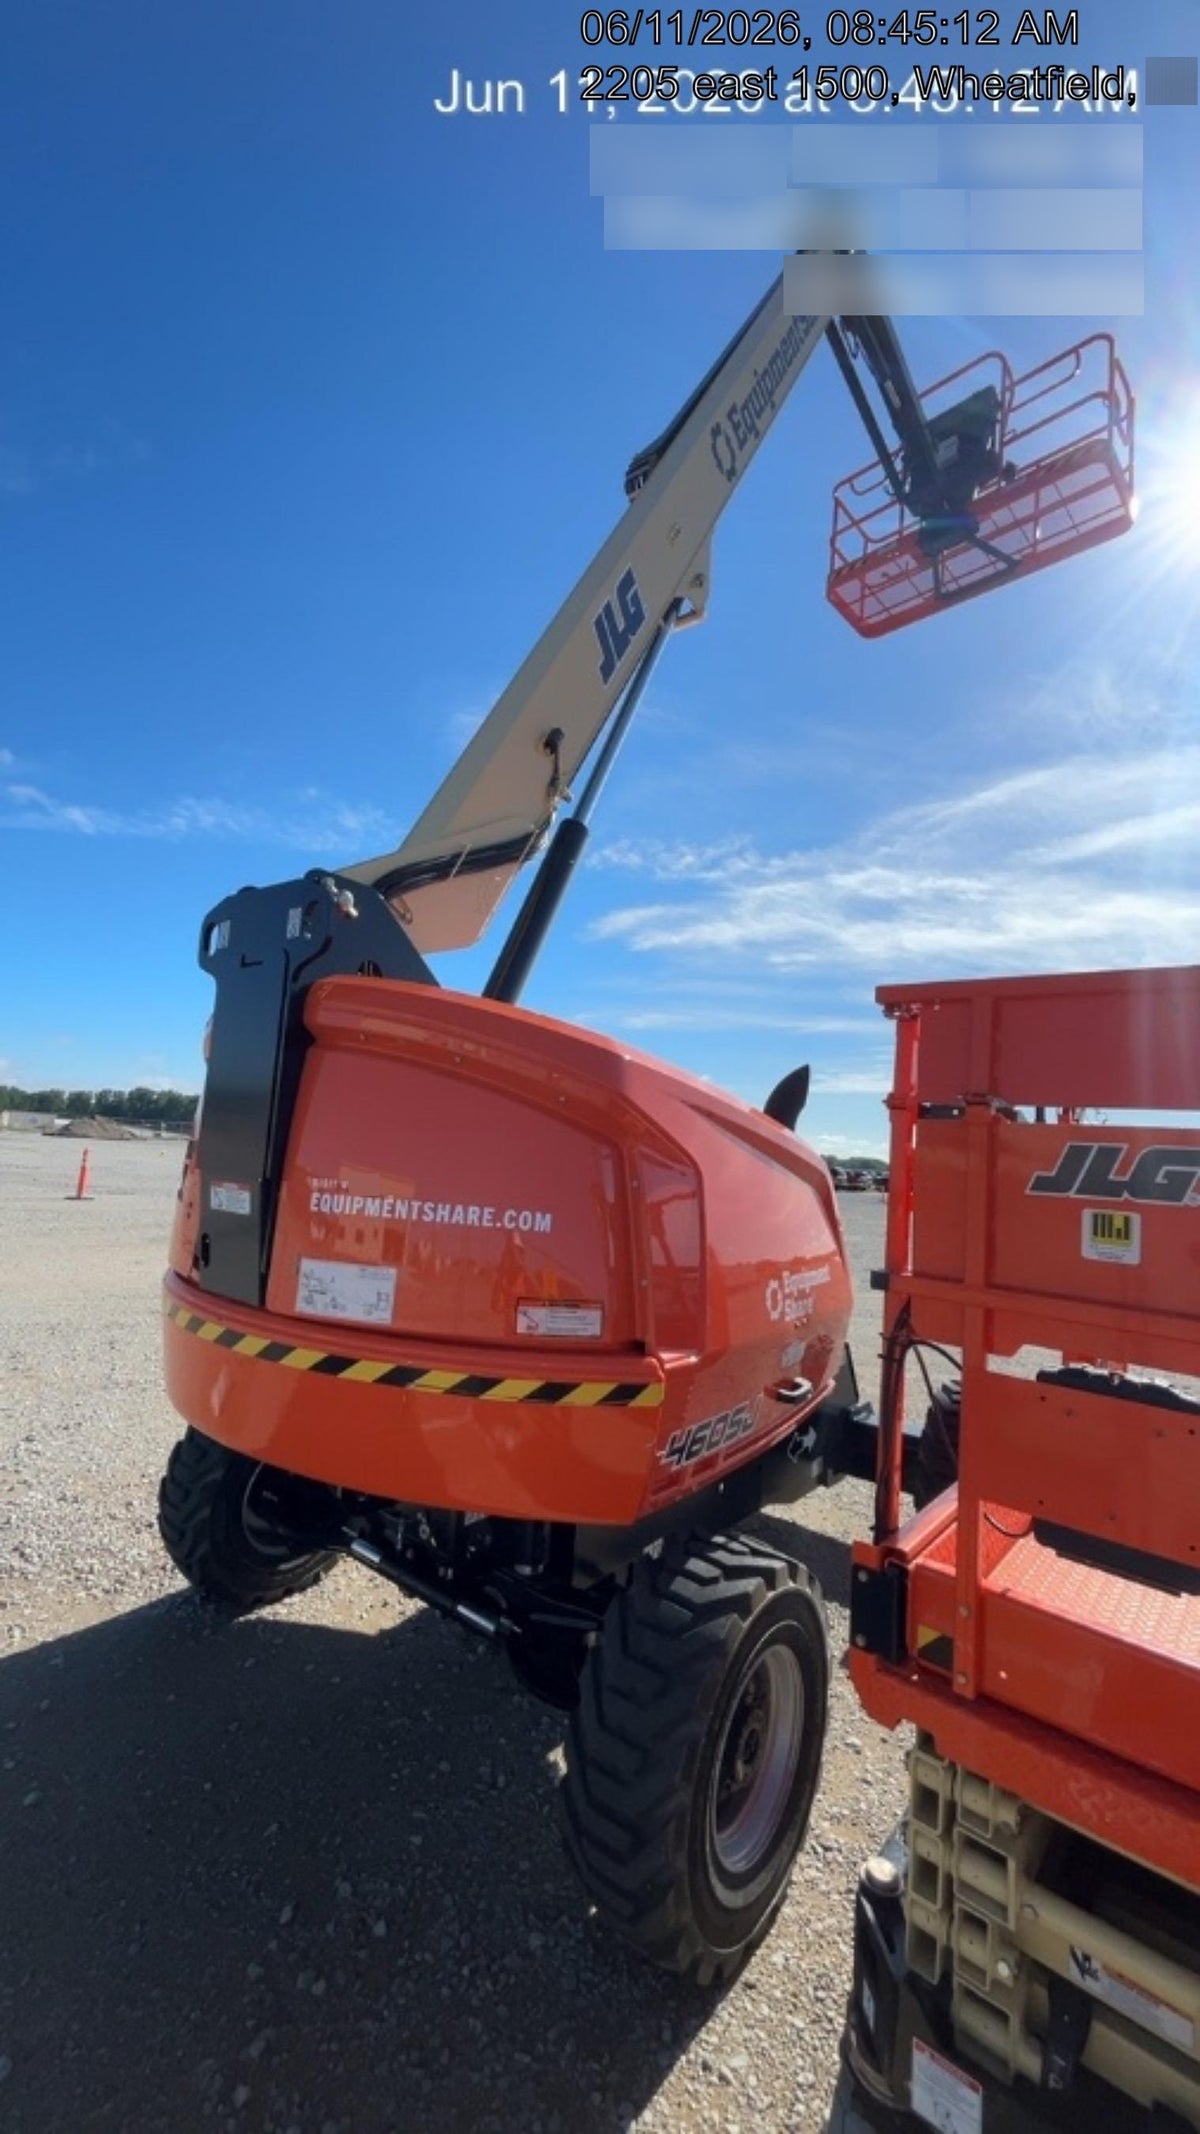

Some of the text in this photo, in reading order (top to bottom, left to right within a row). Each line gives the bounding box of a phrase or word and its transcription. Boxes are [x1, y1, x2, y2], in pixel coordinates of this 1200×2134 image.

[593, 565, 646, 686] JLG
[1025, 1143, 1200, 1205] JLG
[310, 1192, 553, 1233] EQUIPMENTSHARE.COM
